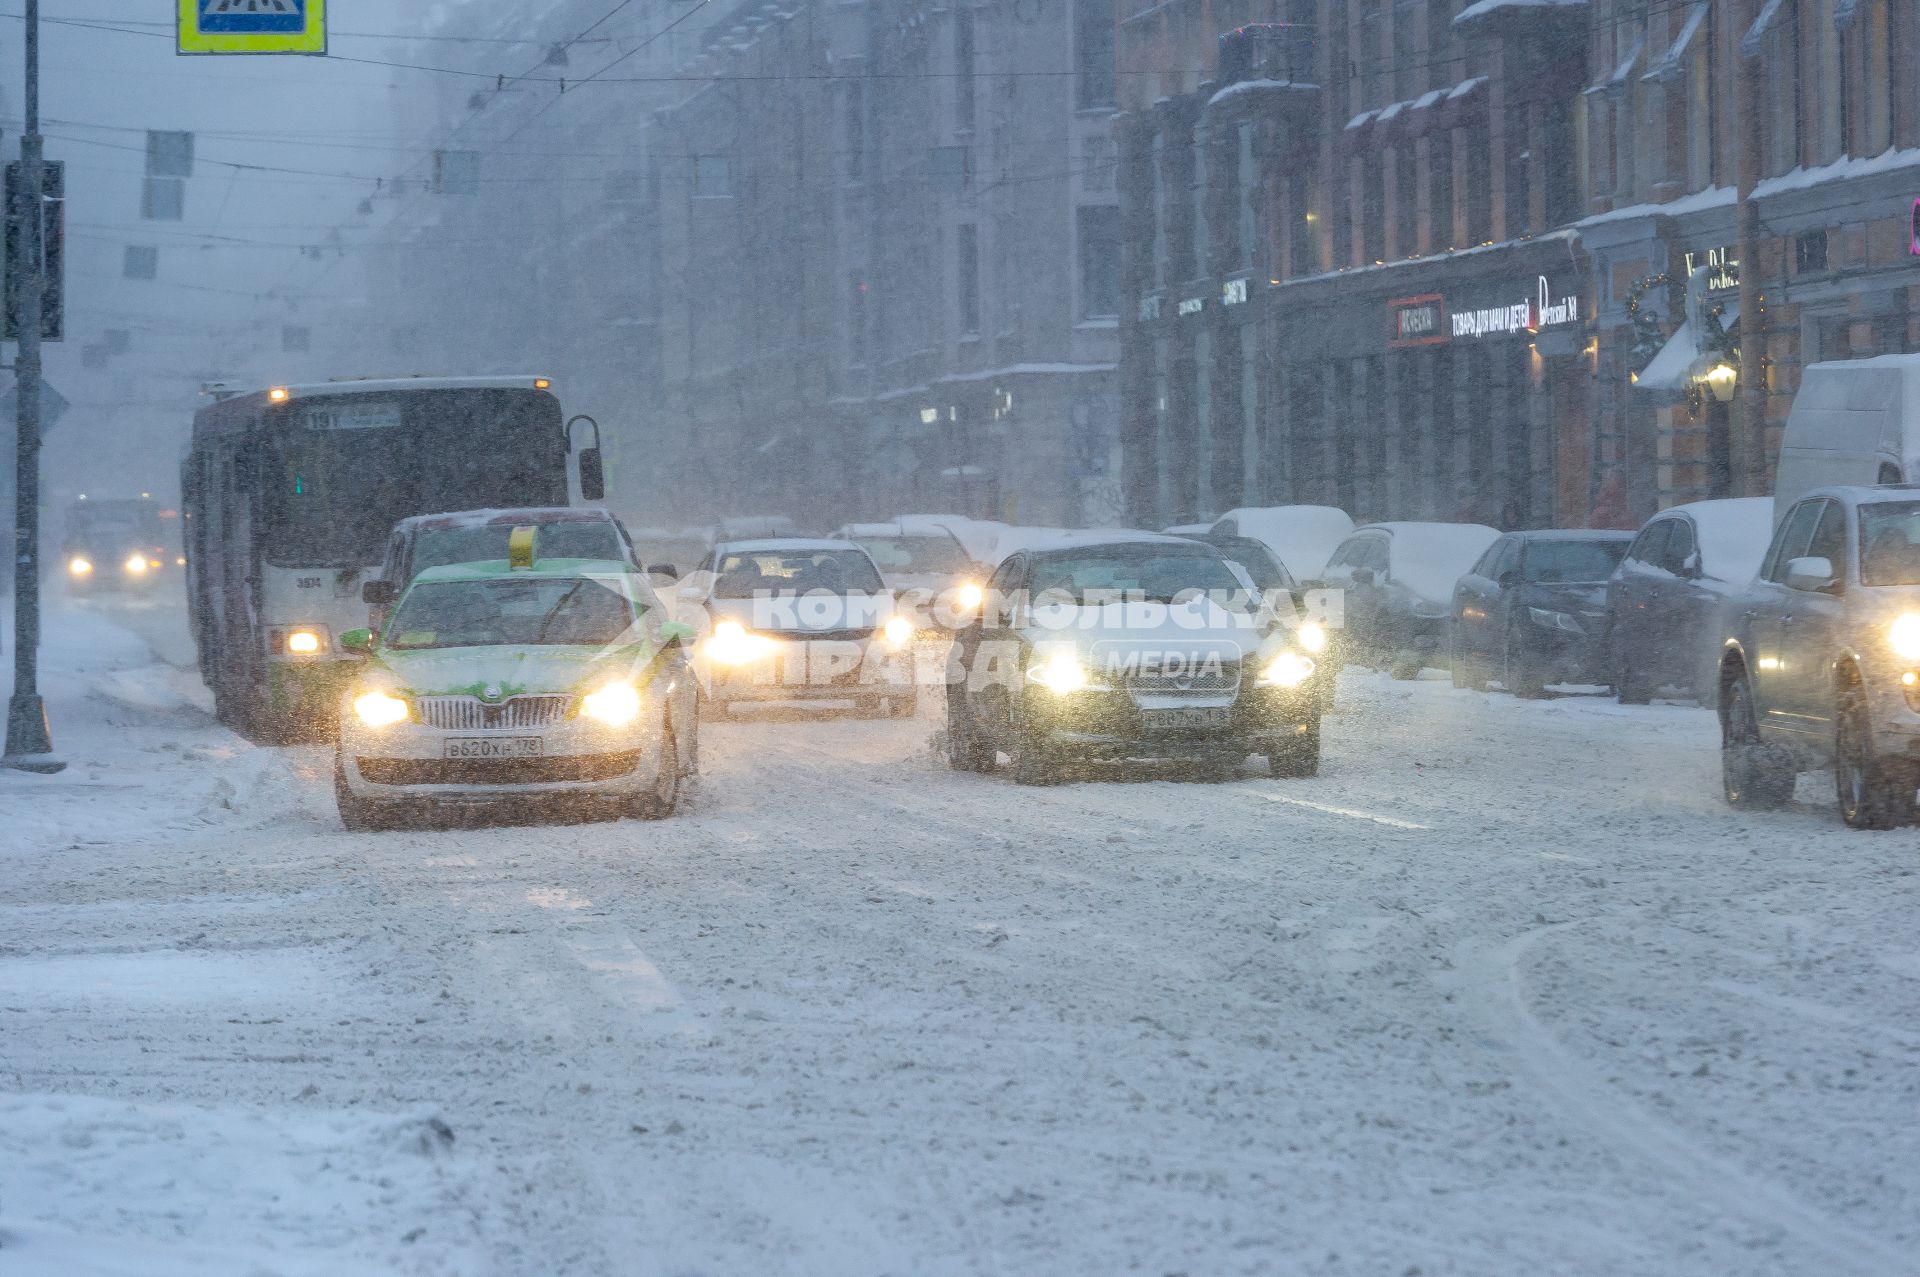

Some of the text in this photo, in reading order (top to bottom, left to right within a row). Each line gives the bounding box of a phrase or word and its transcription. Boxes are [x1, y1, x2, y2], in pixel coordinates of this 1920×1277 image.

[1452, 297, 1530, 339] ТОВАРЫ ДЛЯ МАМ И ДЕТЕЙ
